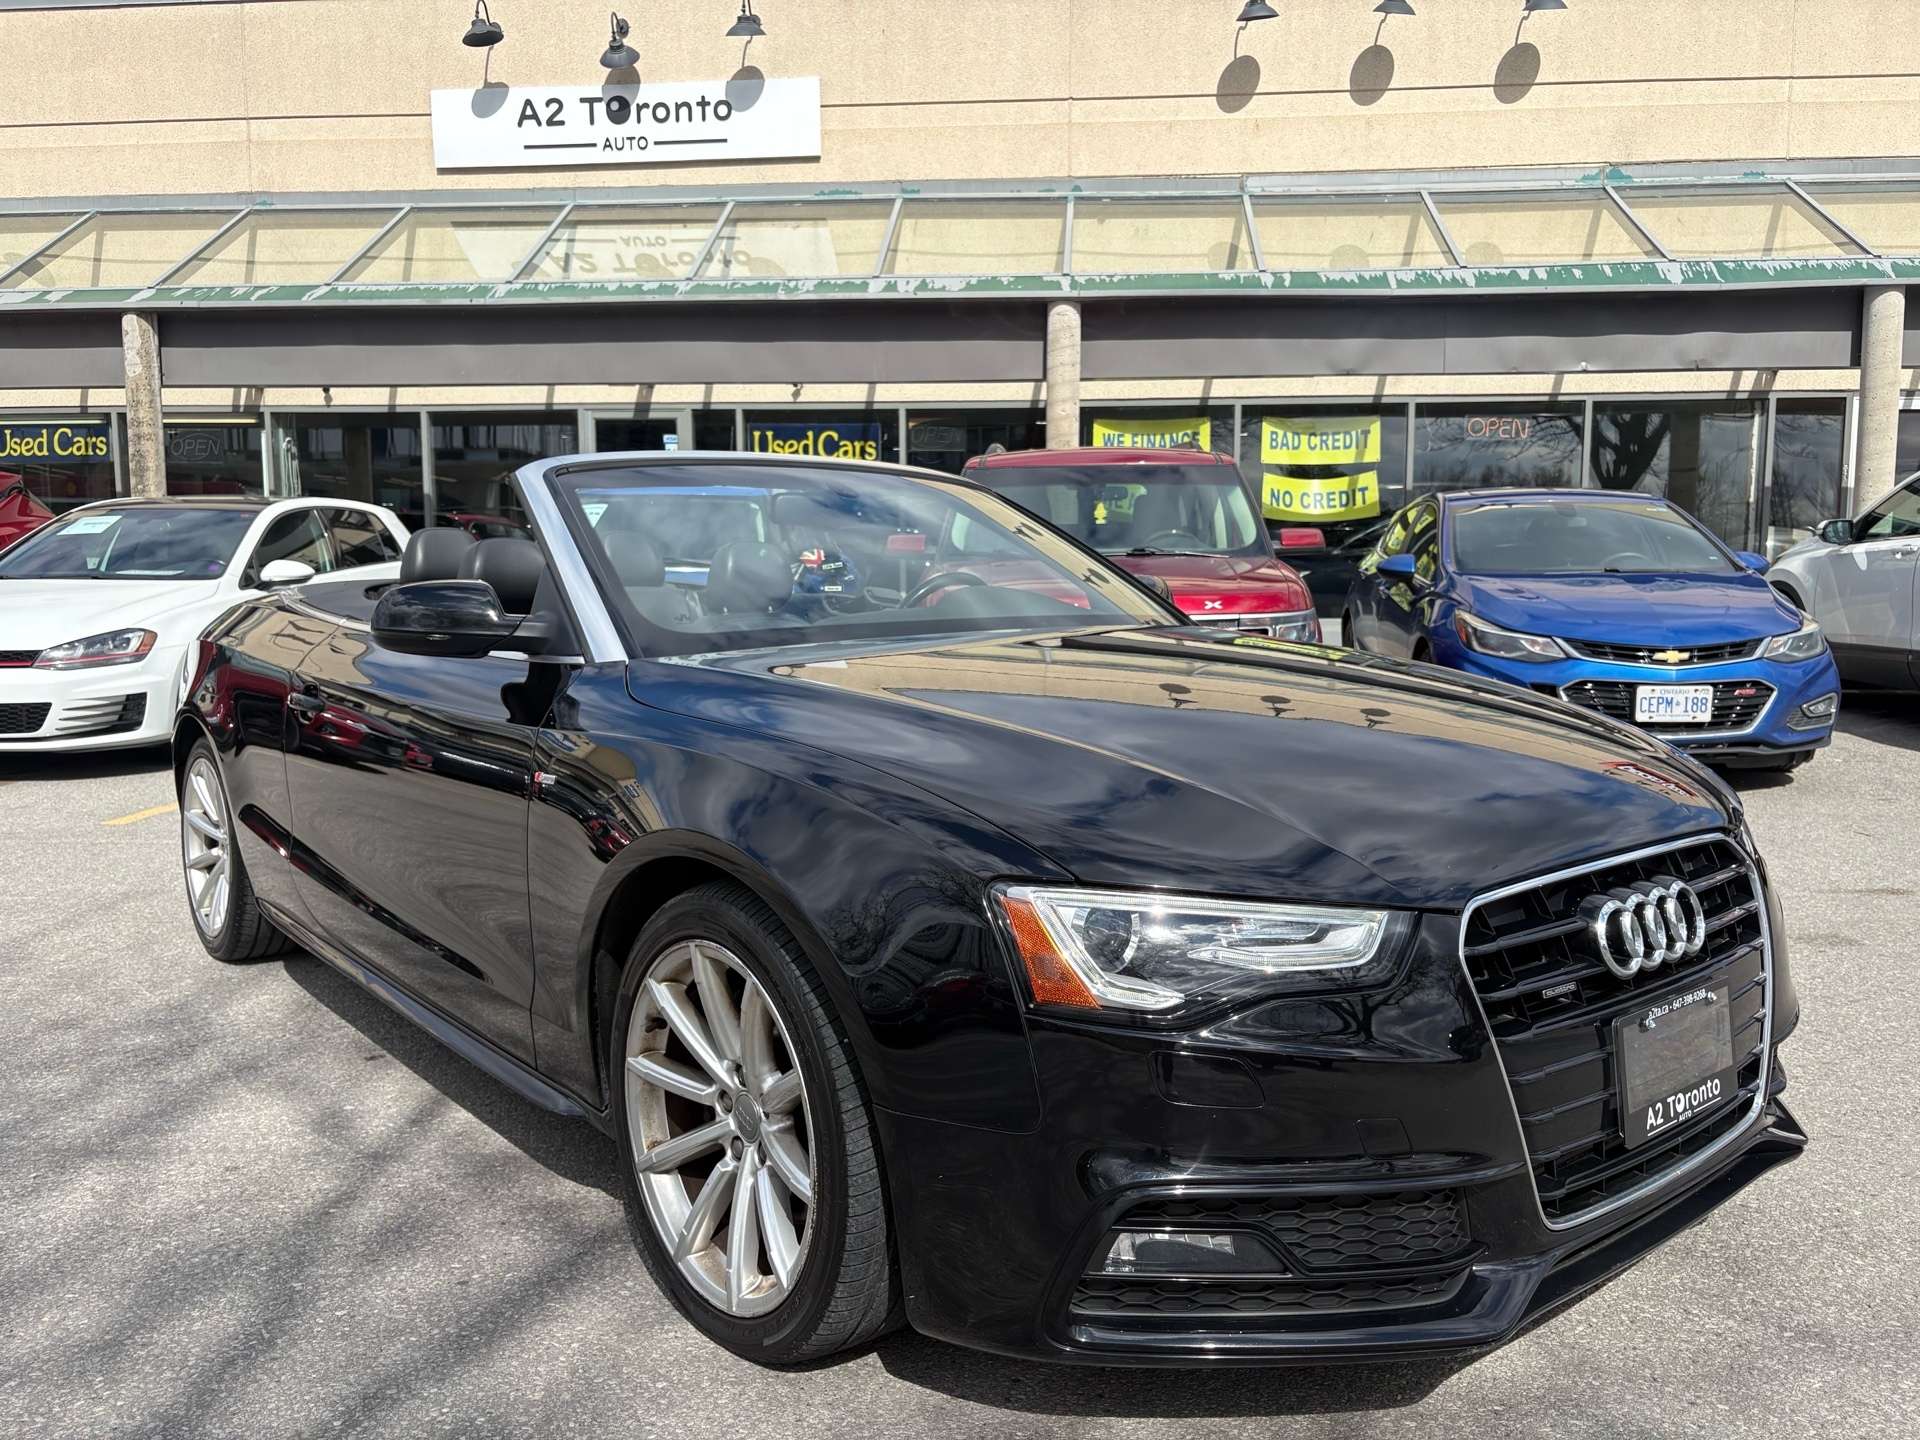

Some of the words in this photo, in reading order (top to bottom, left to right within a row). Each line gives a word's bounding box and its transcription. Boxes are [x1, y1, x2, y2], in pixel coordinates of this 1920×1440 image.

[517, 98, 566, 128] A2
[579, 95, 733, 125] Toronto
[603, 136, 649, 151] AUTO
[1467, 417, 1530, 438] OPEN
[53, 427, 107, 456] Cars
[752, 430, 814, 456] Used
[817, 430, 877, 460] Cars
[1102, 432, 1125, 447] WE
[1270, 431, 1301, 449] BAD
[1307, 429, 1370, 450] CREDIT
[1270, 487, 1294, 508] NO
[1300, 486, 1369, 508] CREDIT
[1640, 696, 1673, 713] CEPM
[1683, 696, 1709, 713] 188
[1646, 1102, 1664, 1130] A2
[1666, 1078, 1721, 1118] Toronto
[1678, 1110, 1692, 1122] AUTO
